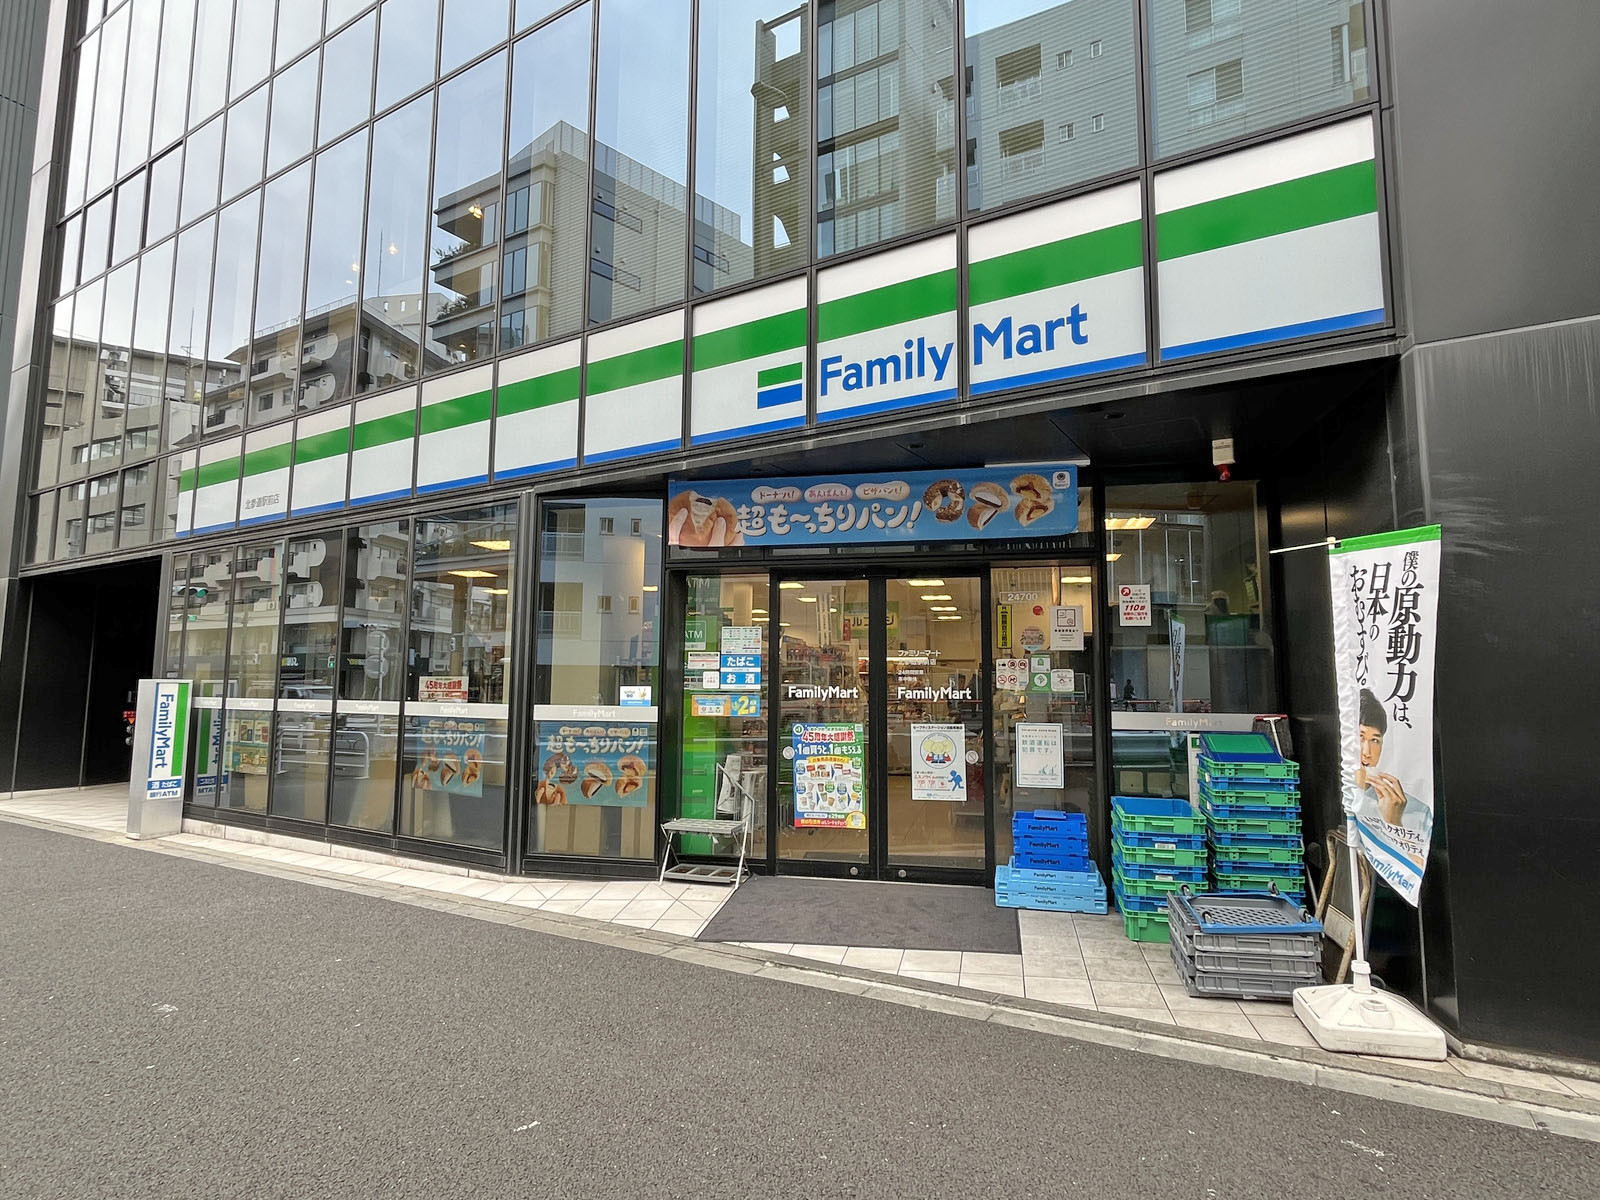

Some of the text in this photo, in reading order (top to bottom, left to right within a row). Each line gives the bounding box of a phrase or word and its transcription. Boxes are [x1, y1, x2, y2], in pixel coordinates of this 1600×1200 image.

[820, 302, 1089, 397] Family Mart
[1366, 561, 1392, 642] 日本の
[726, 656, 755, 667] たばこ
[788, 685, 858, 701] FamilyMart
[897, 686, 972, 702] FamilyMart
[573, 708, 616, 720] FamilyMart
[154, 693, 174, 769] FamilyMart
[1029, 841, 1060, 849] FamilyMart
